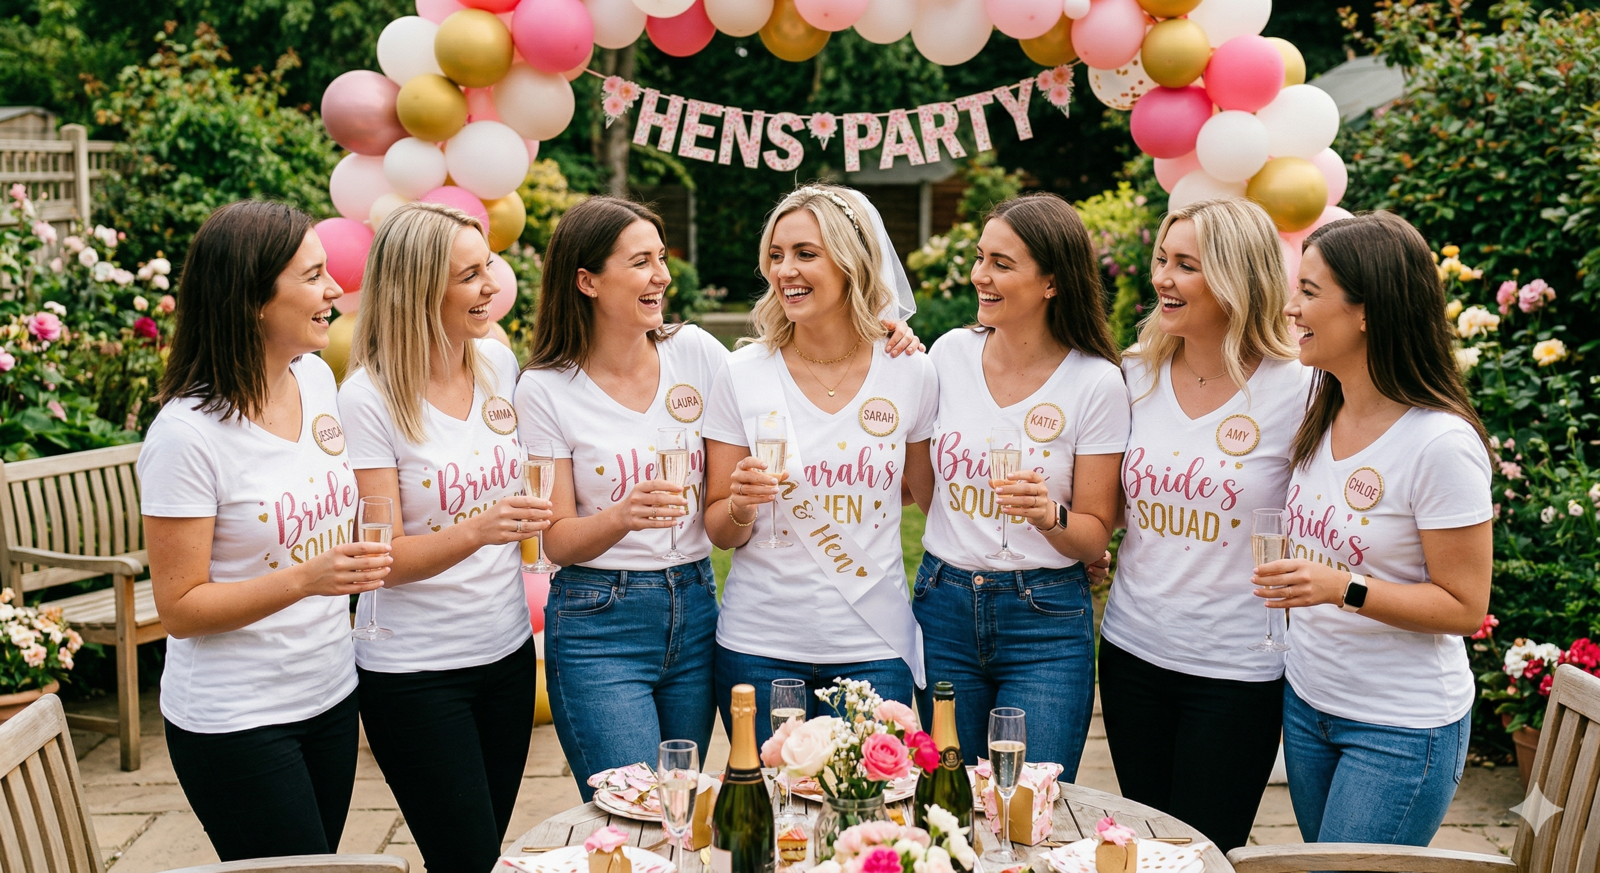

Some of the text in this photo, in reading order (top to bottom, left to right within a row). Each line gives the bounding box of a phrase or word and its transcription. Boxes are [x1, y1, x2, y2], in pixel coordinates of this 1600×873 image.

[632, 77, 1034, 173] HENS PARTY
[671, 396, 700, 410] LAURA
[488, 408, 514, 422] EMMA
[863, 409, 895, 424] SARAH
[1030, 413, 1059, 431] KATIE
[318, 426, 343, 443] JESSICA
[1225, 428, 1250, 443] AMY
[804, 446, 898, 491] arah's
[1124, 447, 1245, 511] Bride's
[1348, 477, 1379, 501] CHLOE
[1136, 500, 1220, 543] SQUAD
[792, 500, 854, 574] & Hen
